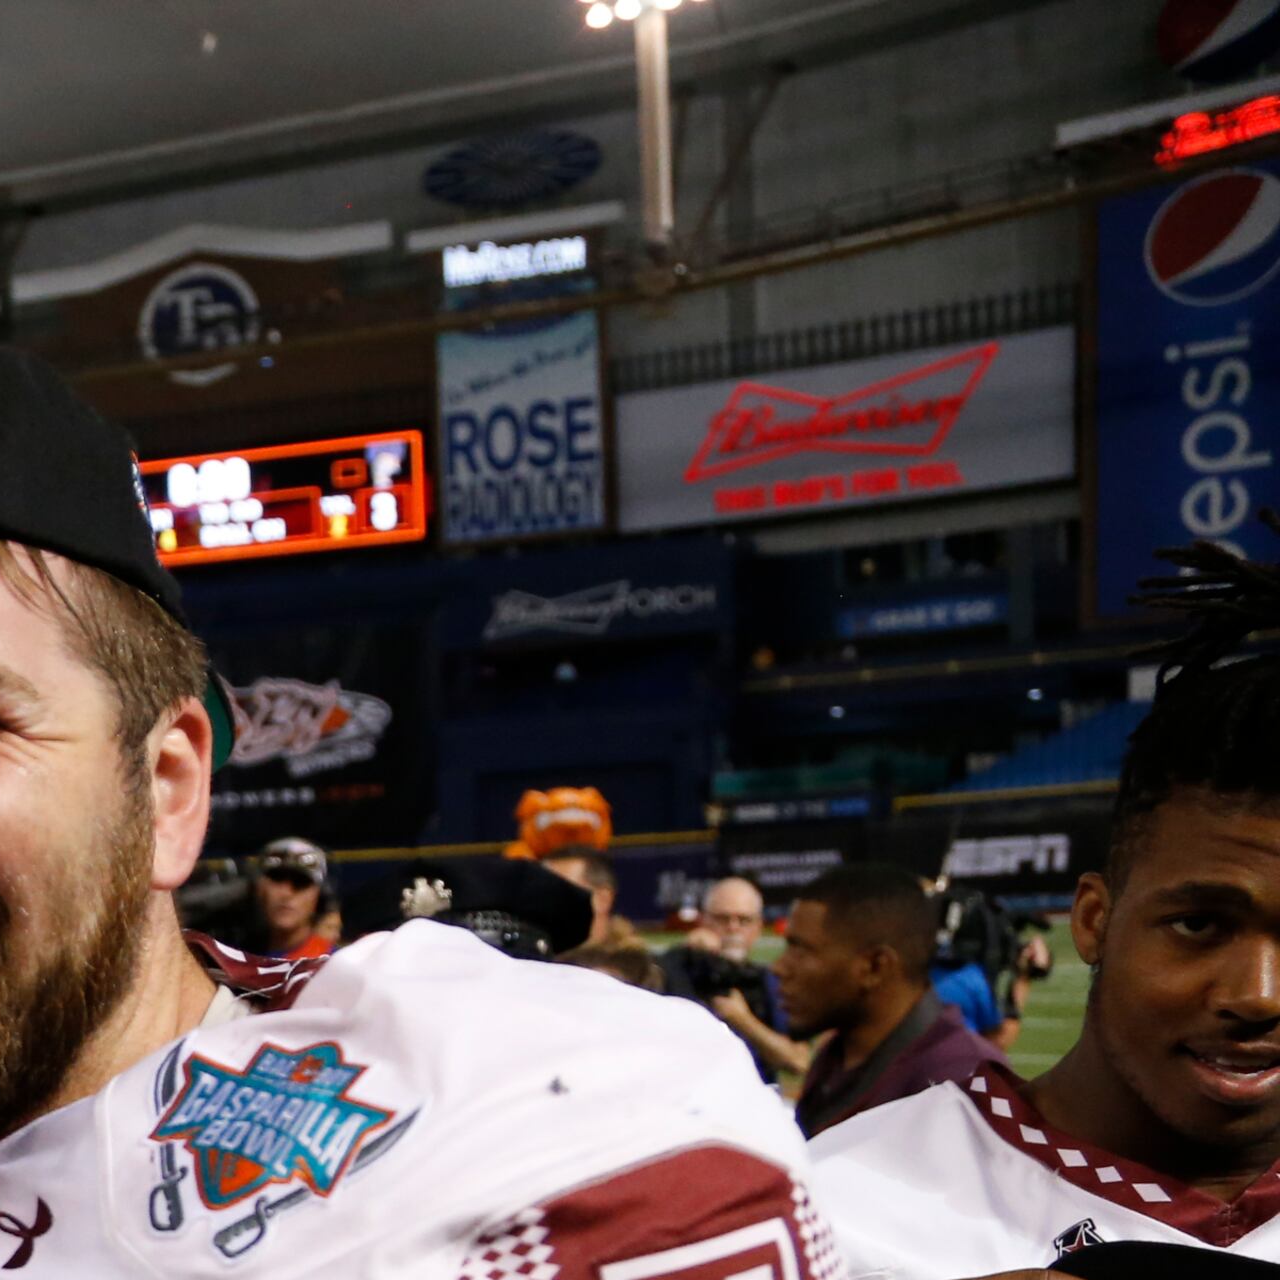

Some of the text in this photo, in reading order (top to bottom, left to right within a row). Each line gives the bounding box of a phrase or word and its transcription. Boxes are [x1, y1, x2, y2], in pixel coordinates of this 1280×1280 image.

[446, 400, 595, 474] ROSE
[708, 396, 966, 453] Budweiser
[1163, 337, 1273, 593] epsi
[446, 471, 599, 536] RADIOLOGY
[949, 832, 1071, 878] ESPN
[166, 1069, 370, 1178] GASPARILLA
[196, 1118, 297, 1177] BOWL
